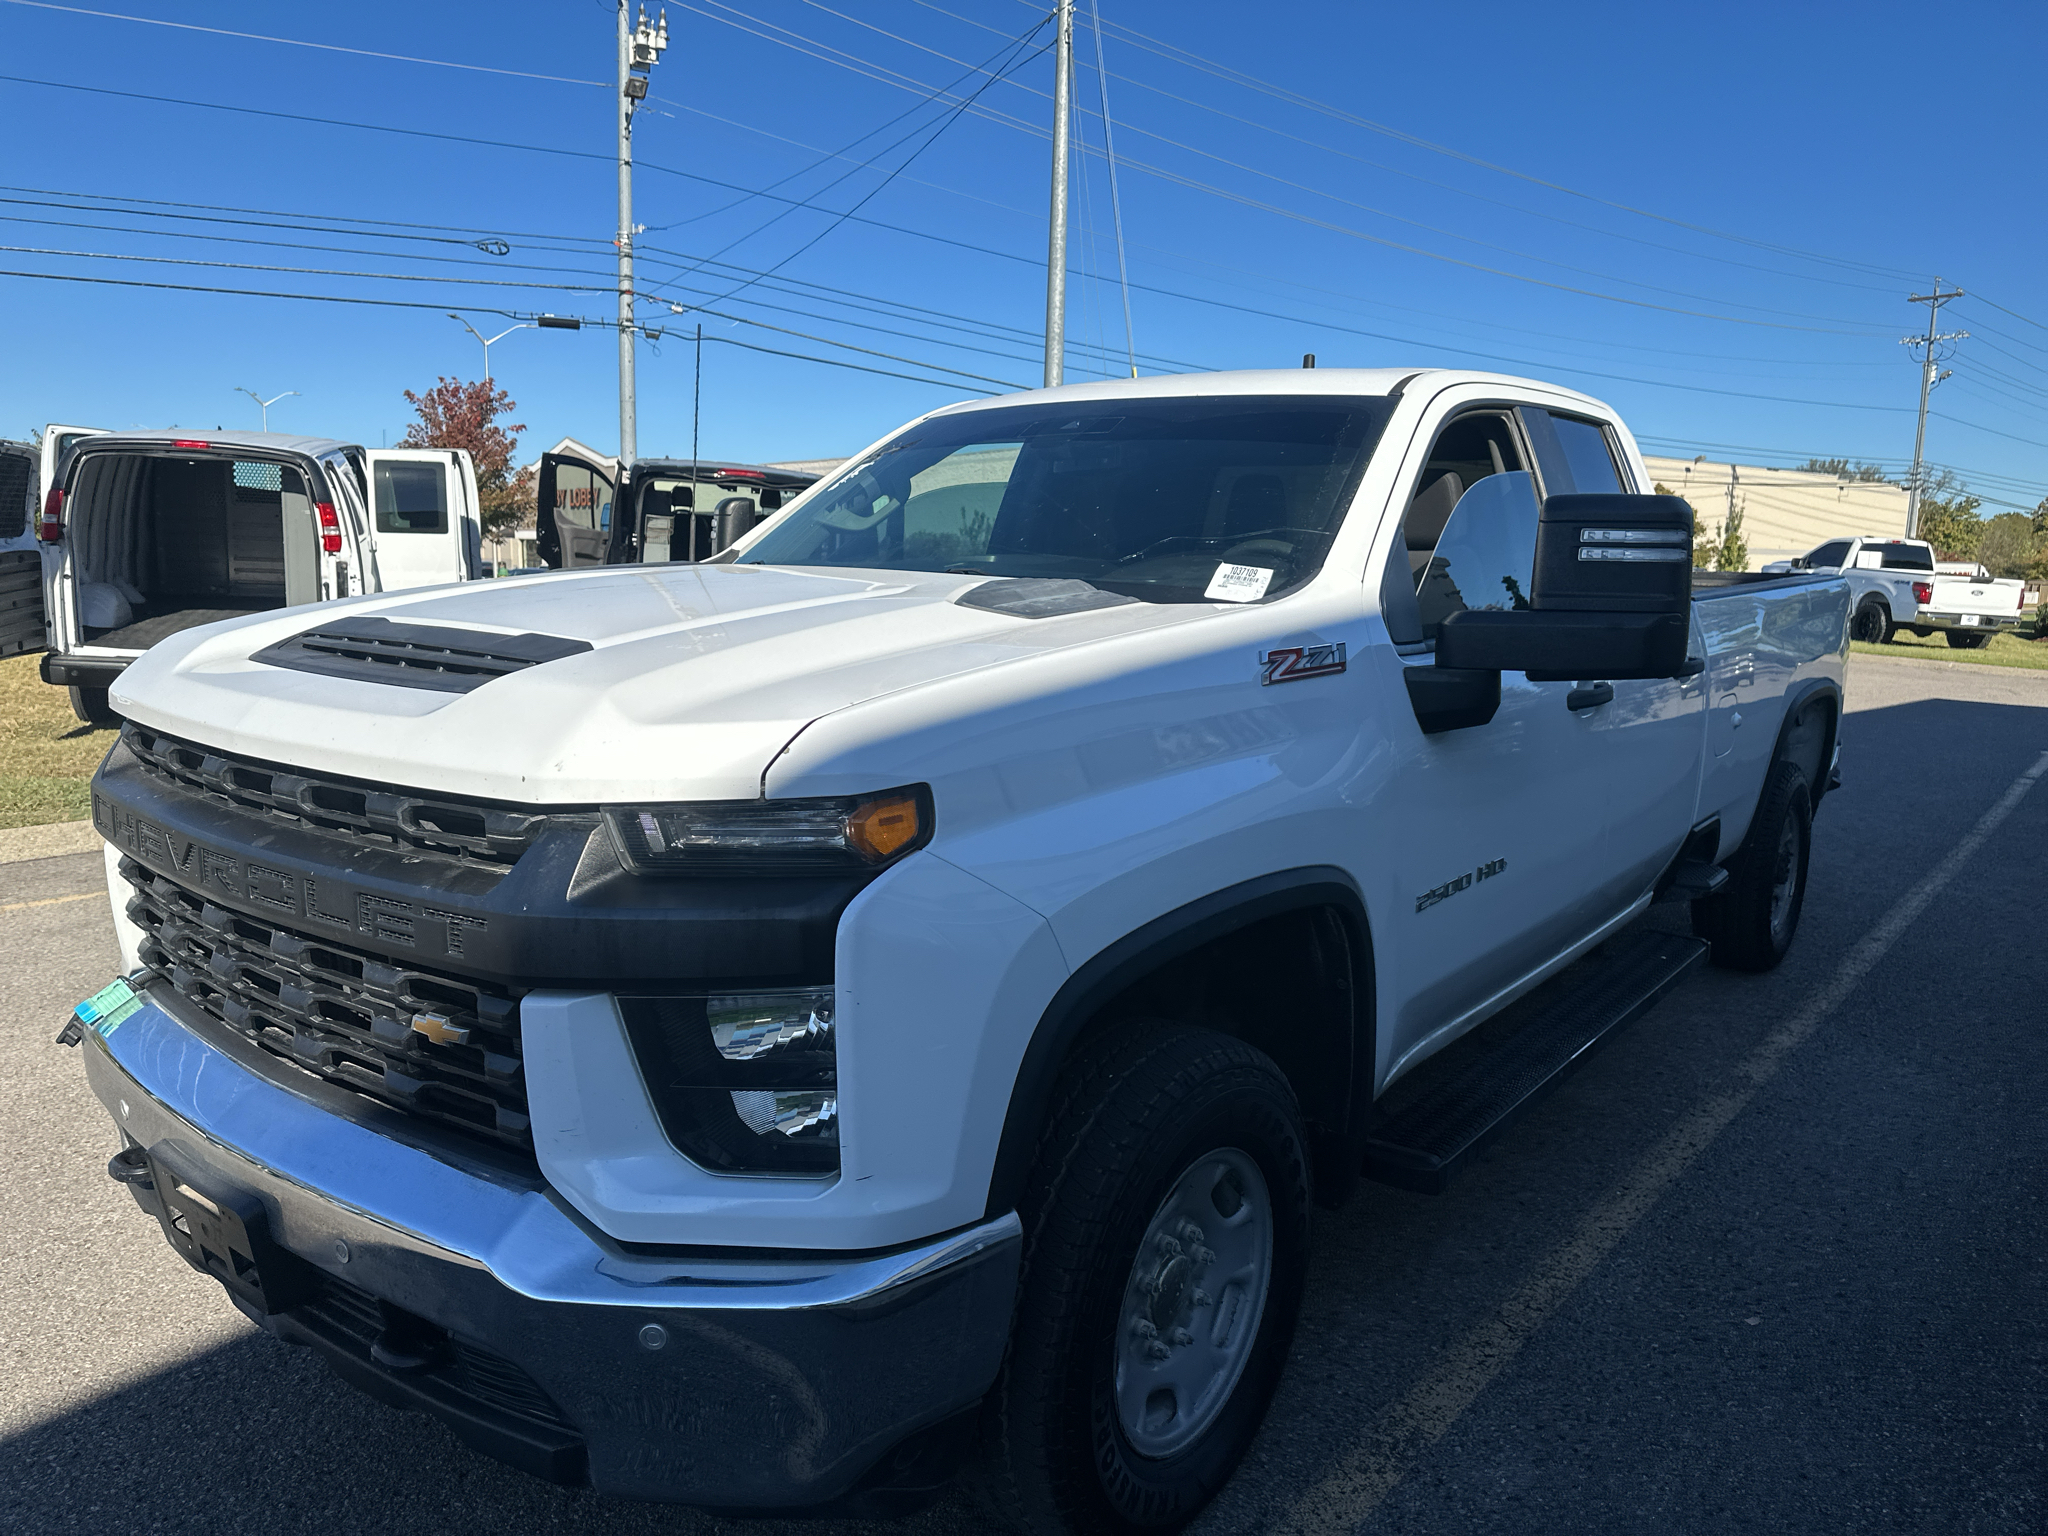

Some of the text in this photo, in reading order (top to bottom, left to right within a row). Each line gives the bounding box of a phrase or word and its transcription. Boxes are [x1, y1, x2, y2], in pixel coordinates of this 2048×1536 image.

[1229, 566, 1259, 578] 1037109
[1259, 641, 1346, 687] Z71
[95, 793, 489, 959] CHEVROLET
[1415, 857, 1505, 914] 2500 HD
